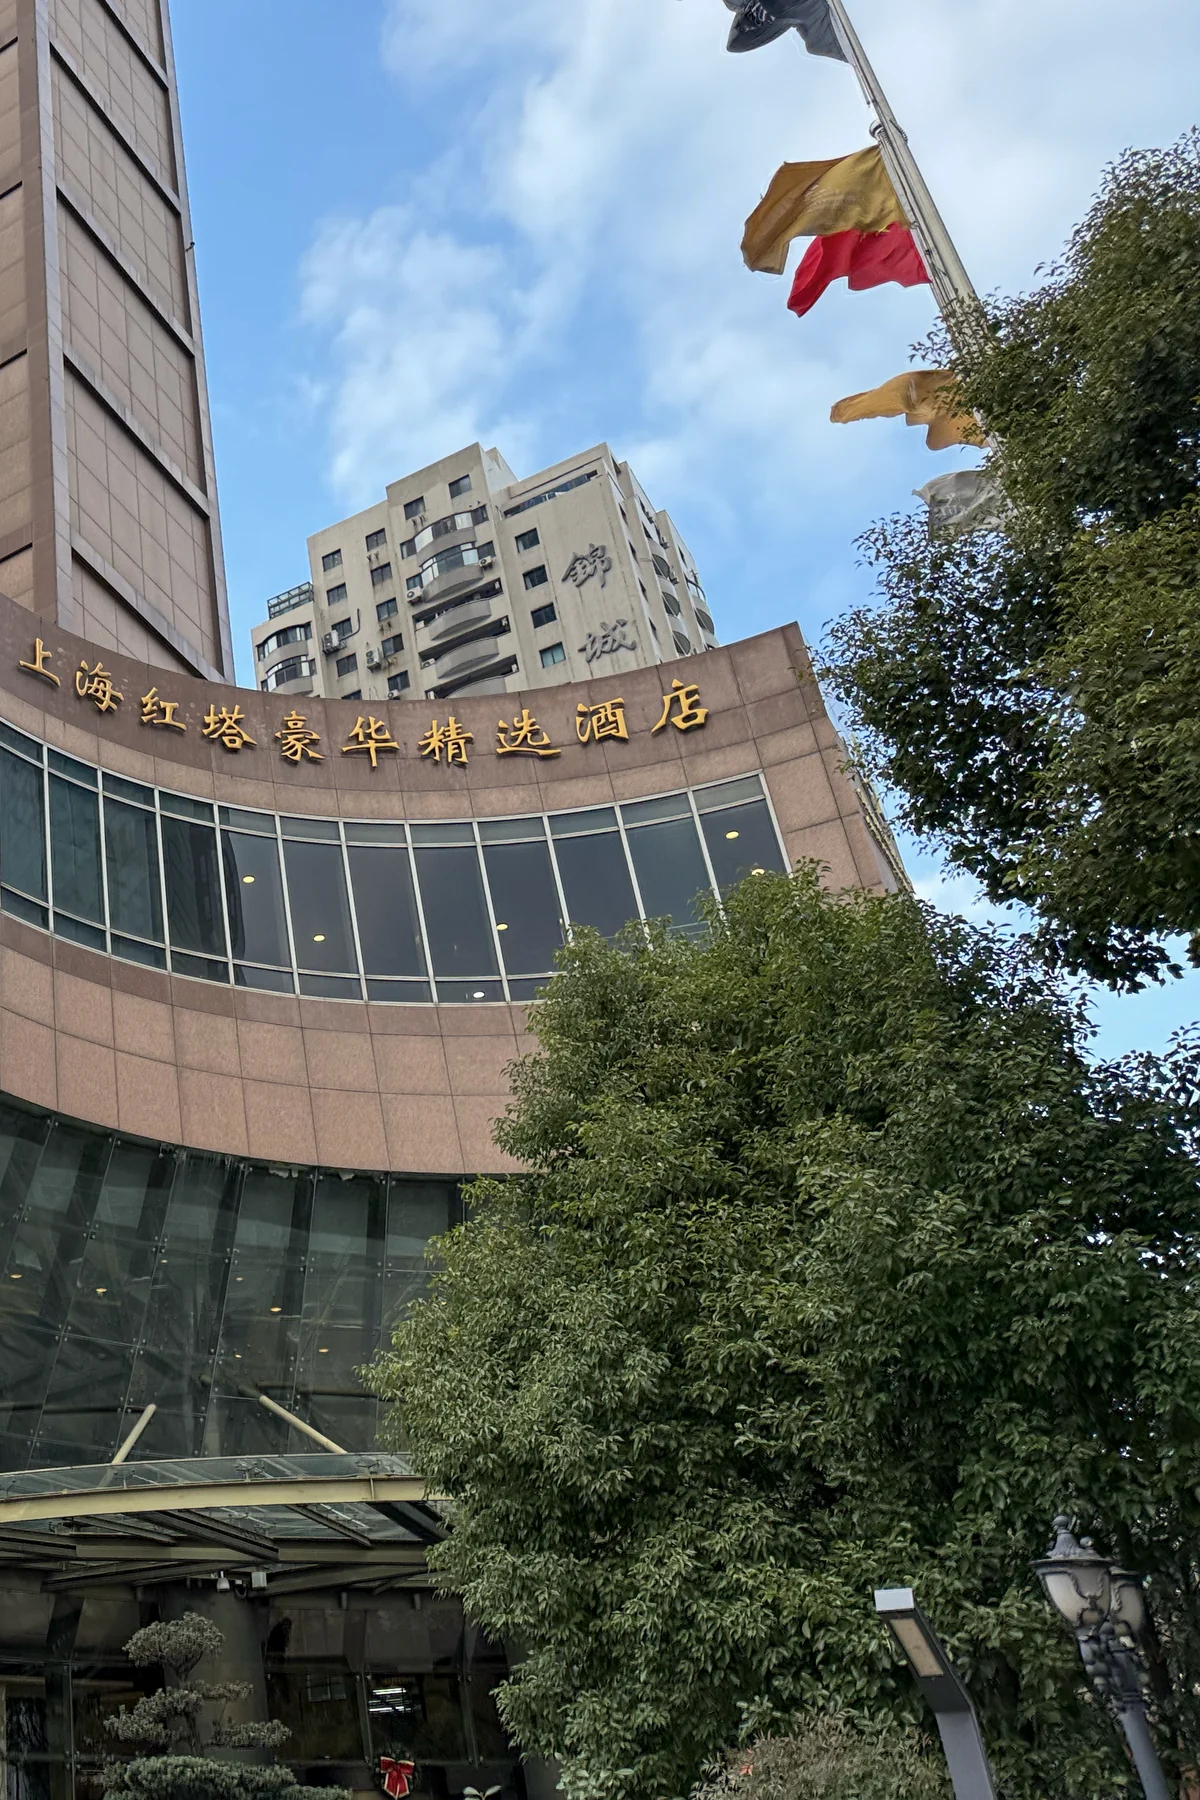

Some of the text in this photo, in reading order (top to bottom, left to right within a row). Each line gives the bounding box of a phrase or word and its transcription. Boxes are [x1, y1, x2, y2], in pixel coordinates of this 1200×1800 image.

[19, 638, 709, 768] 上海红塔豪华精选酒店
